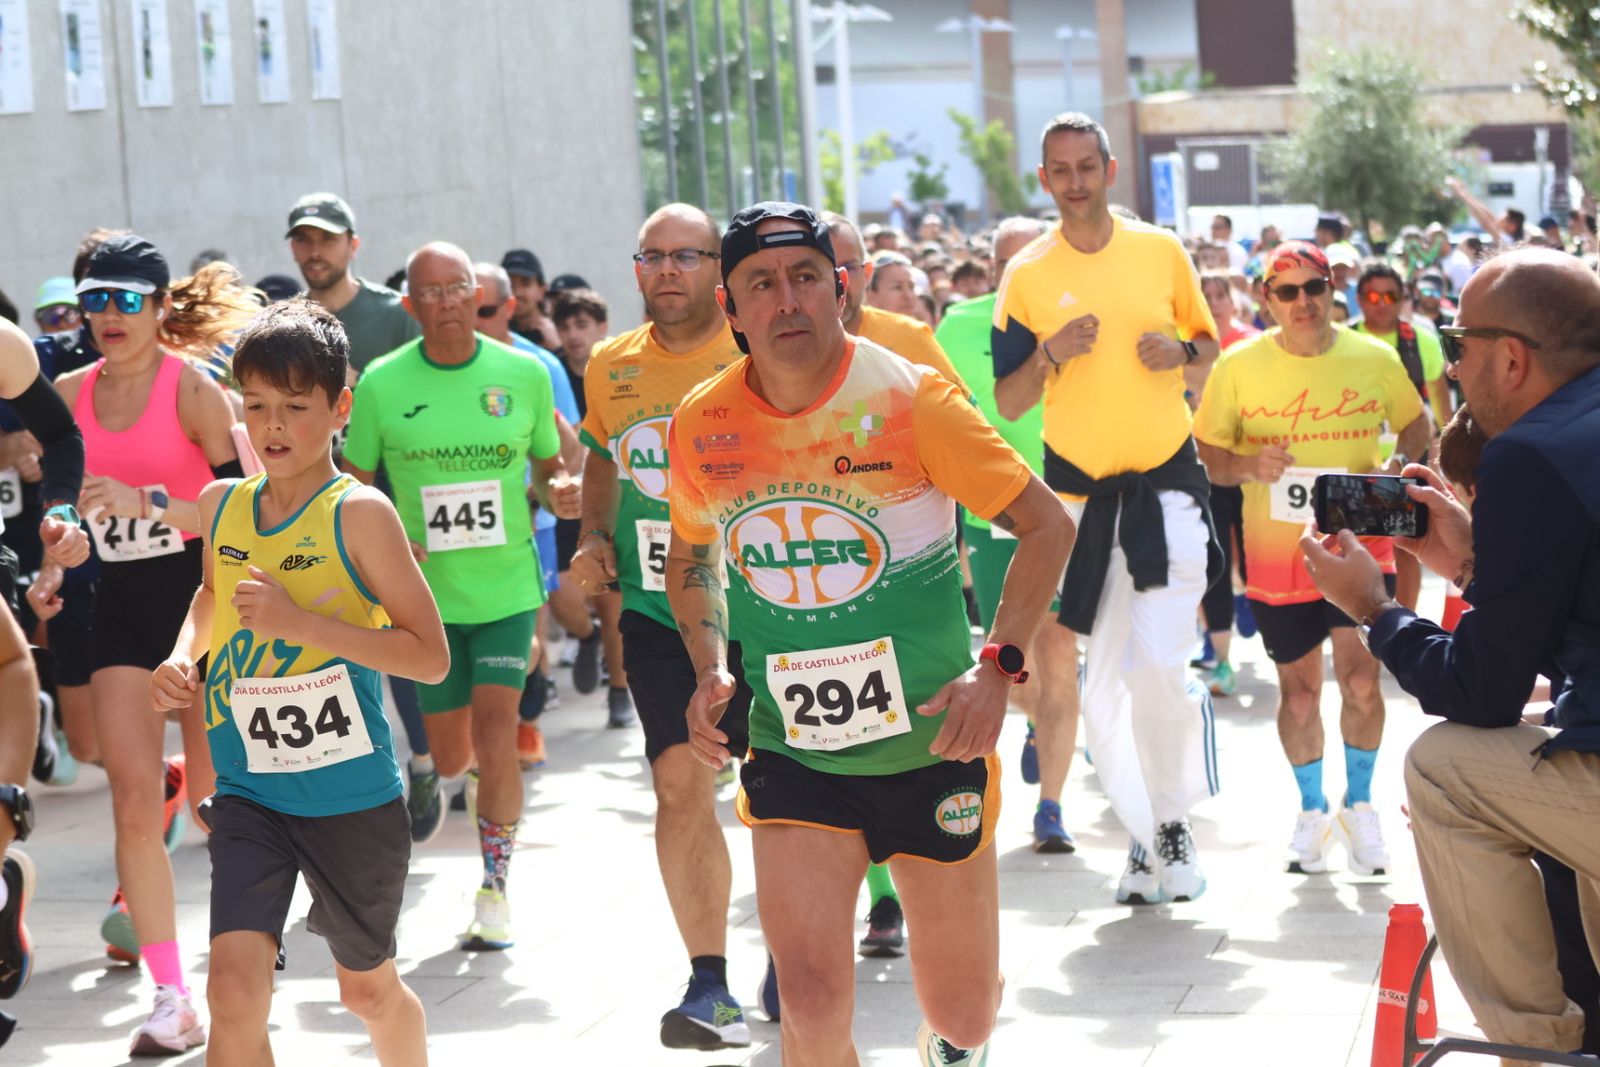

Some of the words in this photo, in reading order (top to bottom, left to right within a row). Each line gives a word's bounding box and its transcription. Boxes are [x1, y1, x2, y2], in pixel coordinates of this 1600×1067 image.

[703, 406, 731, 419] EKT
[438, 458, 499, 472] TELECOM
[629, 448, 669, 469] AL
[428, 500, 496, 533] 445
[719, 490, 757, 525] CLUB
[767, 482, 879, 519] DEPORTIVO
[741, 539, 872, 569] ALCER
[791, 662, 803, 671] DE
[805, 656, 849, 669] CASTILLA
[851, 654, 857, 663] Y
[234, 684, 248, 695] DÍA
[249, 687, 260, 695] DE
[262, 684, 304, 695] CASTILLA
[305, 682, 312, 691] Y
[315, 673, 342, 689] LEÓN
[784, 669, 892, 726] 294
[248, 695, 352, 749] 434
